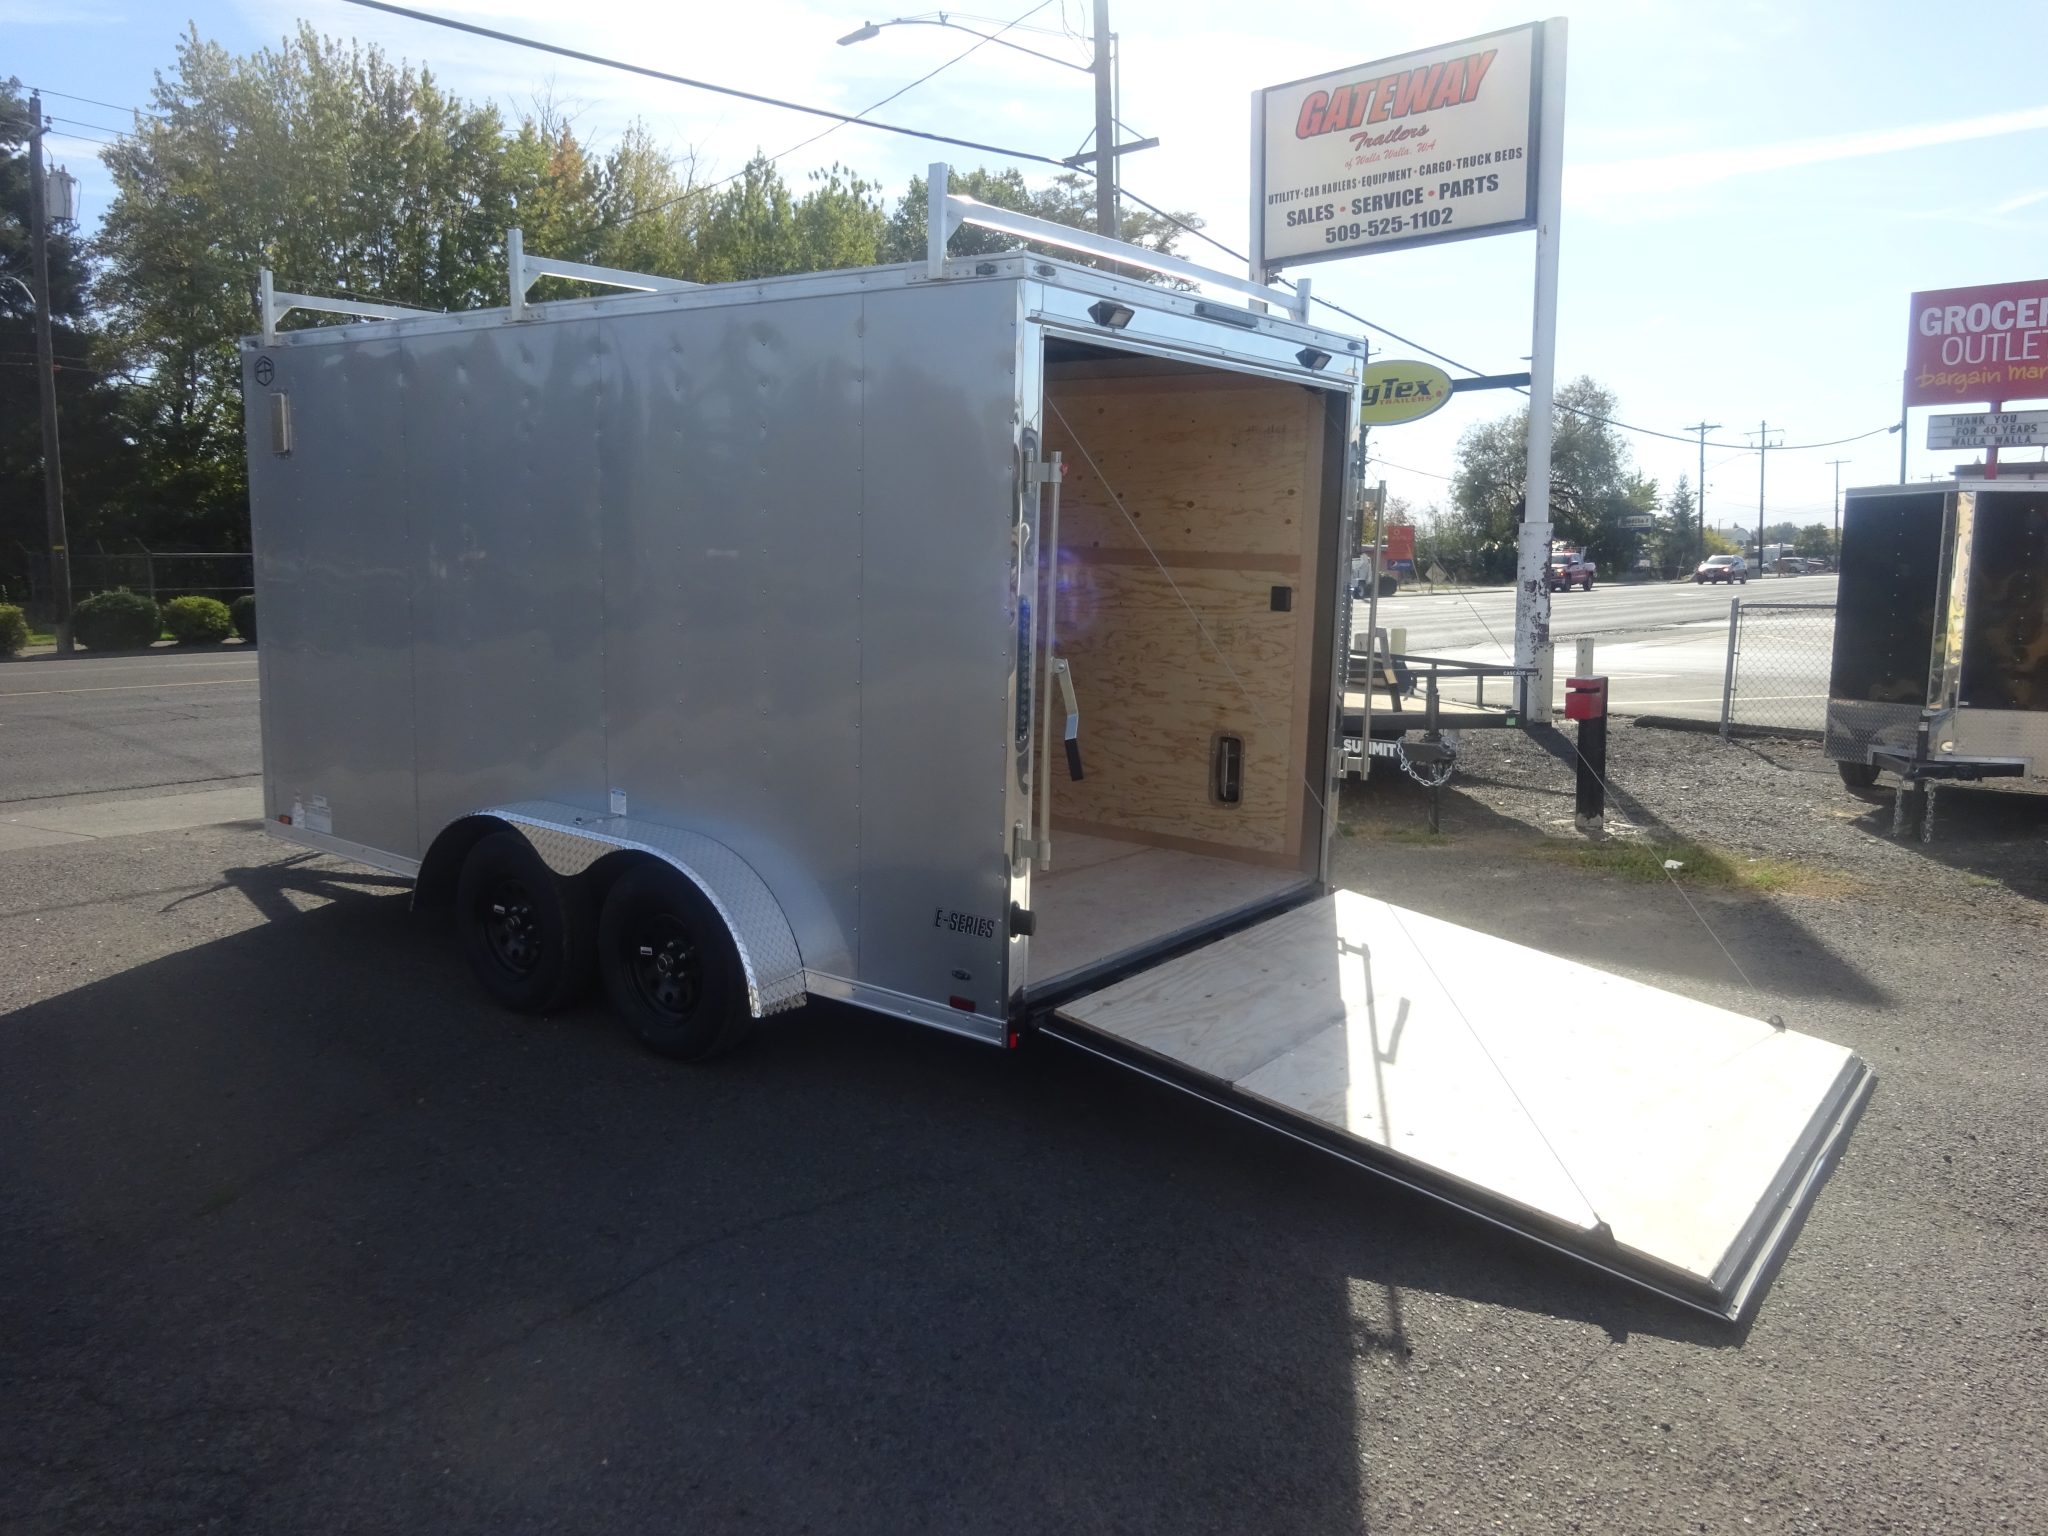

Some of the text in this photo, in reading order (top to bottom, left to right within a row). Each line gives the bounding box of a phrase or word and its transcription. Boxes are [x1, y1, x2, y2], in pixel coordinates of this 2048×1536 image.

[1296, 49, 1498, 140] GATEWAY
[1349, 124, 1430, 151] Trailers
[1355, 152, 1381, 166] Walla
[1268, 147, 1523, 205] UTILITY CAR HAULERS EQUIPMENT CARGO TRUCK BEDS
[1286, 173, 1499, 227] SALES SERVICE PARTS
[1325, 207, 1453, 245] 509-525-1102
[1915, 364, 2001, 394] bargain
[1379, 394, 1432, 405] TRAILERS
[1950, 414, 2017, 426] THANK YOU
[1955, 424, 2038, 436] FOR 40 YEARS
[1951, 435, 2032, 447] WALLA WALLA
[1343, 738, 1397, 757] SUMIT
[935, 908, 995, 938] E-SERIES
